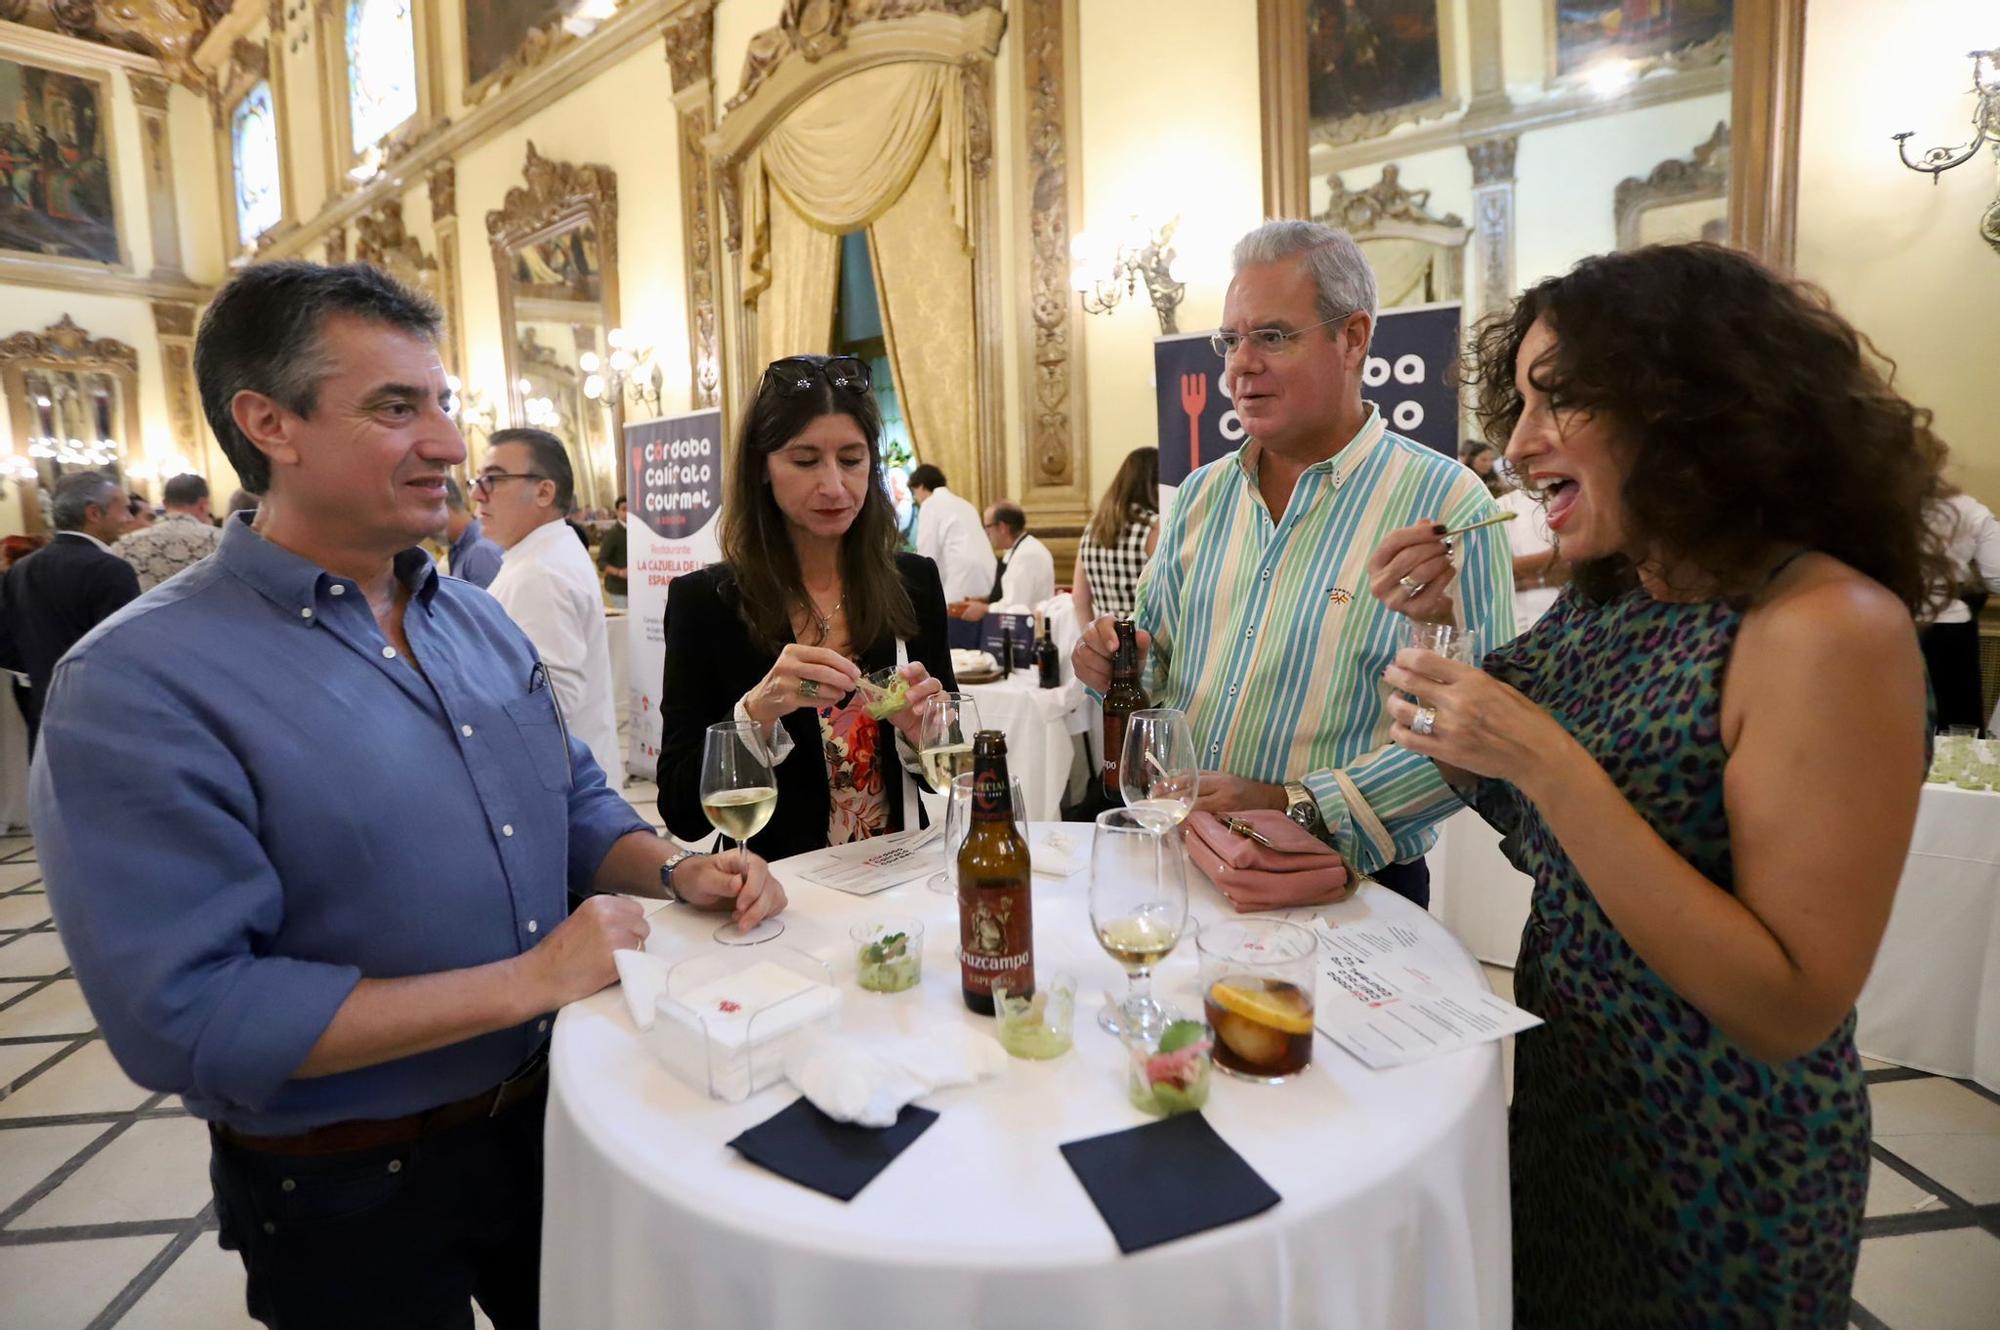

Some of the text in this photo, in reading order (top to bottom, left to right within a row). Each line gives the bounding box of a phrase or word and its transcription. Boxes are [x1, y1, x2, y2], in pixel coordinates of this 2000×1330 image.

[637, 560, 647, 571] LA
[648, 560, 682, 572] CAZUELA
[683, 560, 695, 571] DE
[959, 950, 1030, 971] ruzcampo
